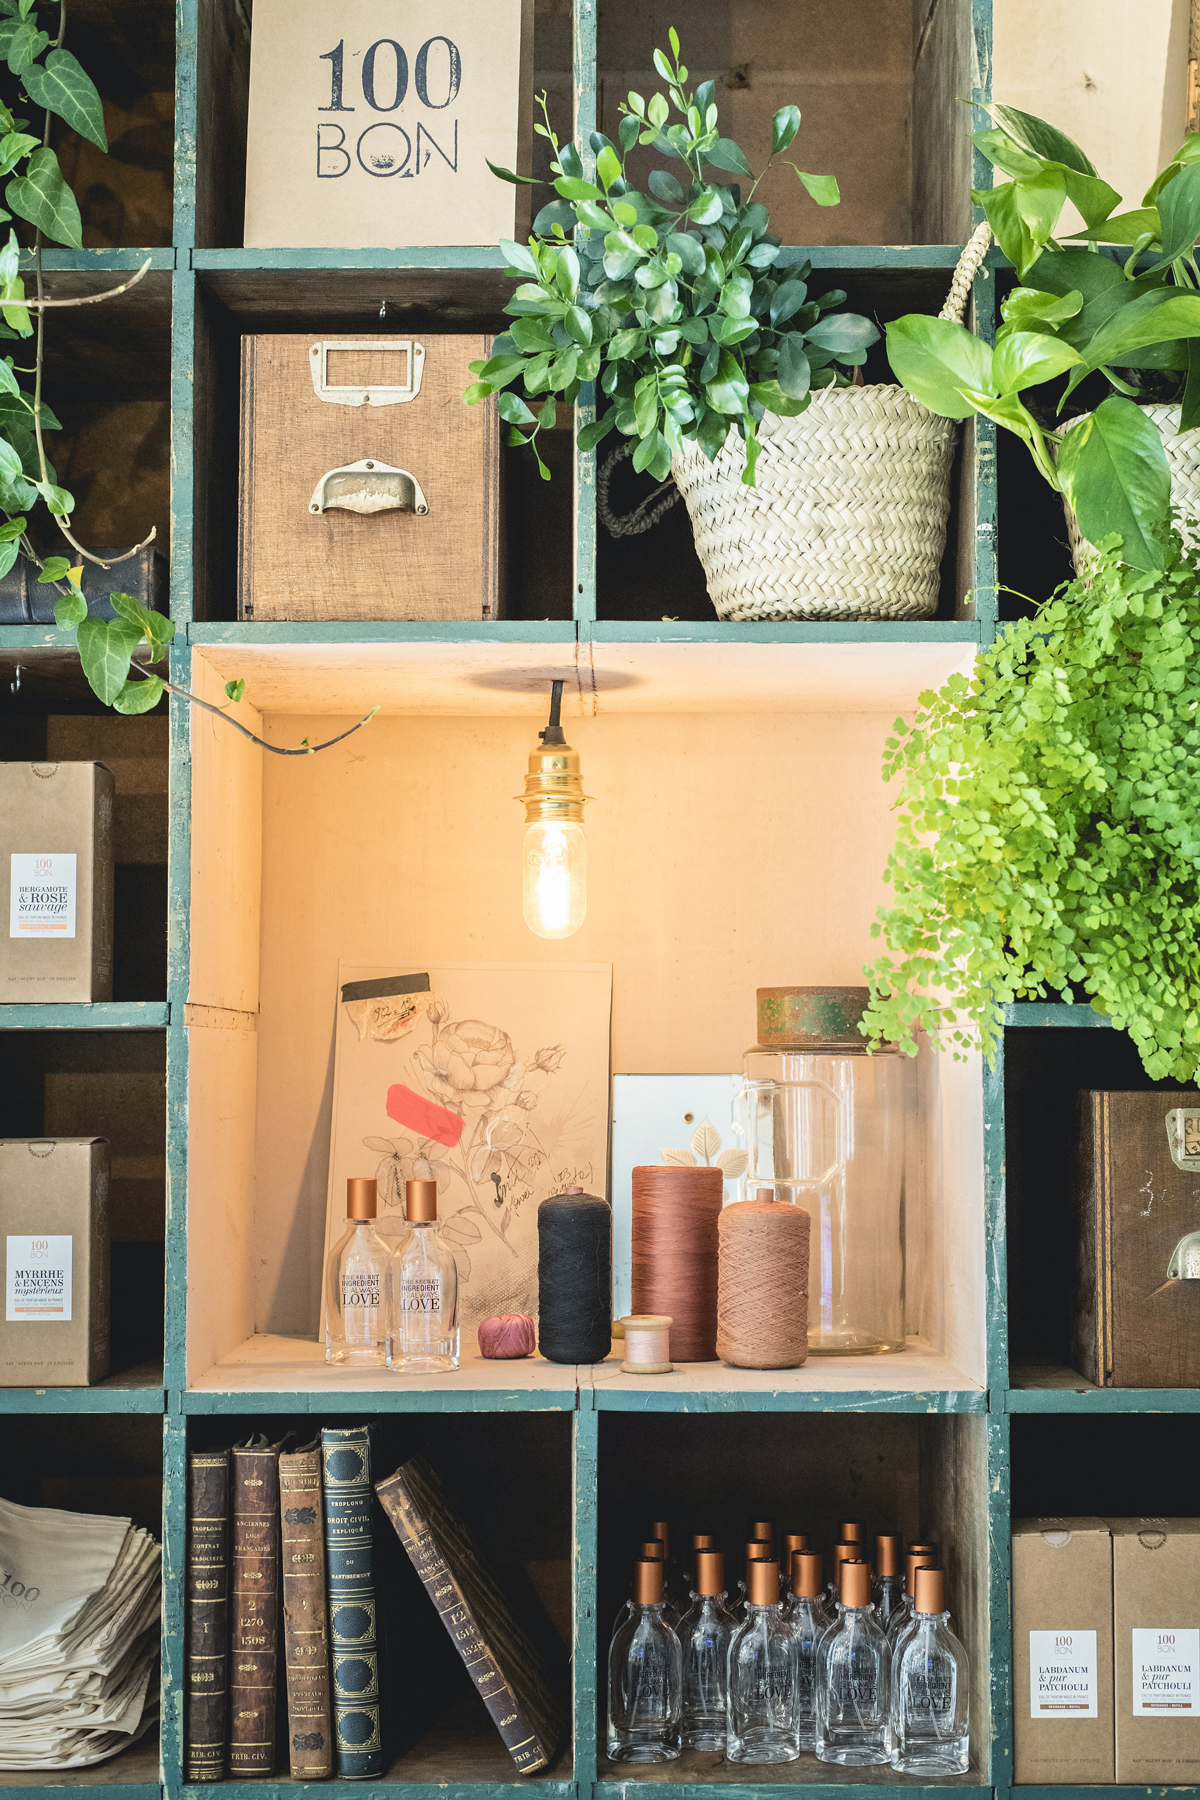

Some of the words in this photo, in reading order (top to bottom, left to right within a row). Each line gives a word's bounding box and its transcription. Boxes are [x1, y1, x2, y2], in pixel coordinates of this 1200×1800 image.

[318, 36, 461, 112] 100
[317, 119, 458, 178] BON
[35, 859, 52, 868] 100
[34, 869, 52, 877] BON
[19, 893, 28, 903] &
[31, 893, 68, 903] ROSE
[19, 904, 67, 914] sauvage
[31, 1241, 48, 1250] 100
[30, 1251, 48, 1259] BON
[15, 1270, 64, 1278] MYRRHE
[23, 1279, 64, 1287] ENCENS
[15, 1286, 64, 1296] mystérieux
[343, 1293, 380, 1305] LOVE
[402, 1298, 439, 1310] LOVE
[0, 1573, 41, 1602] 100
[248, 1600, 257, 1611] 2
[240, 1618, 264, 1627] 1270
[1055, 1636, 1073, 1646] 100
[1158, 1634, 1176, 1645] 100
[1054, 1647, 1073, 1655] BON
[1157, 1645, 1175, 1653] BON
[1141, 1665, 1191, 1673] LABDANUM
[1039, 1674, 1046, 1682] &
[1049, 1675, 1067, 1685] pur
[1141, 1673, 1149, 1681] &
[1151, 1674, 1170, 1683] pur
[1142, 1682, 1191, 1690] PATCHOULI
[756, 1685, 791, 1700] LOVE
[839, 1688, 878, 1700] LOVE
[913, 1697, 951, 1709] LOVE
[191, 1751, 207, 1759] RIB.
